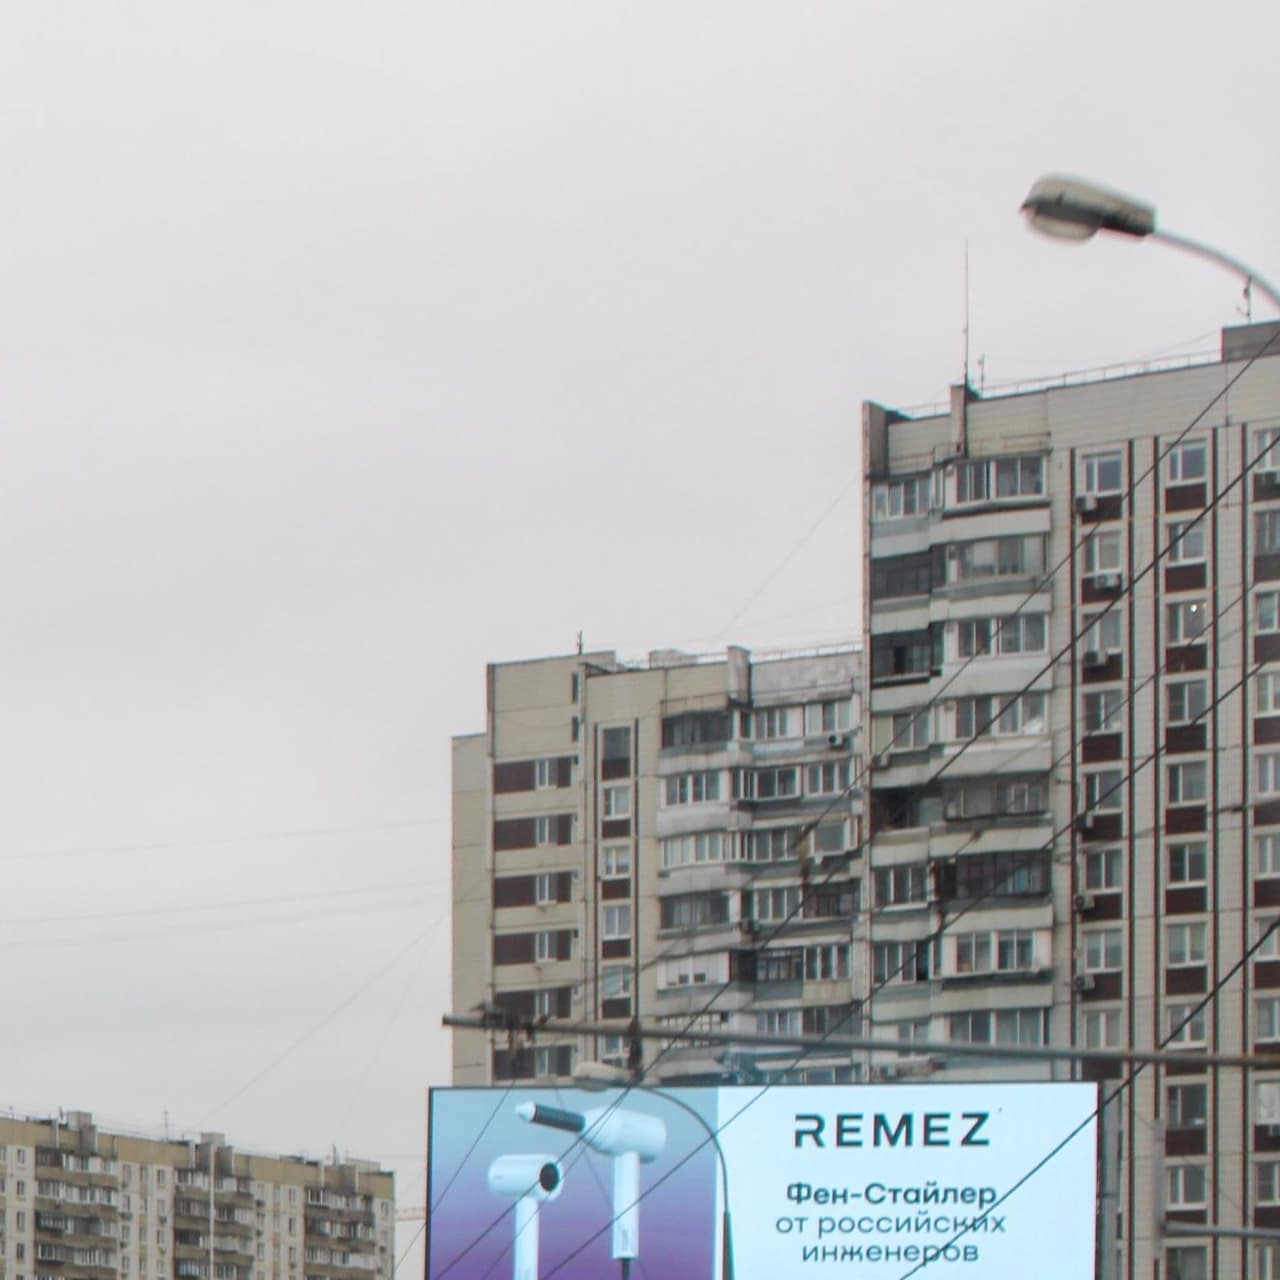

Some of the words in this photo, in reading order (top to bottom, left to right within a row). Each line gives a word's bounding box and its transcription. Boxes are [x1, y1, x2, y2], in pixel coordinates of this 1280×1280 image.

[794, 1112, 990, 1148] REMEZ
[786, 1181, 997, 1210] Фен-Стайлер
[775, 1215, 809, 1235] от
[817, 1209, 1008, 1239] российских
[801, 1243, 980, 1266] инженеров
